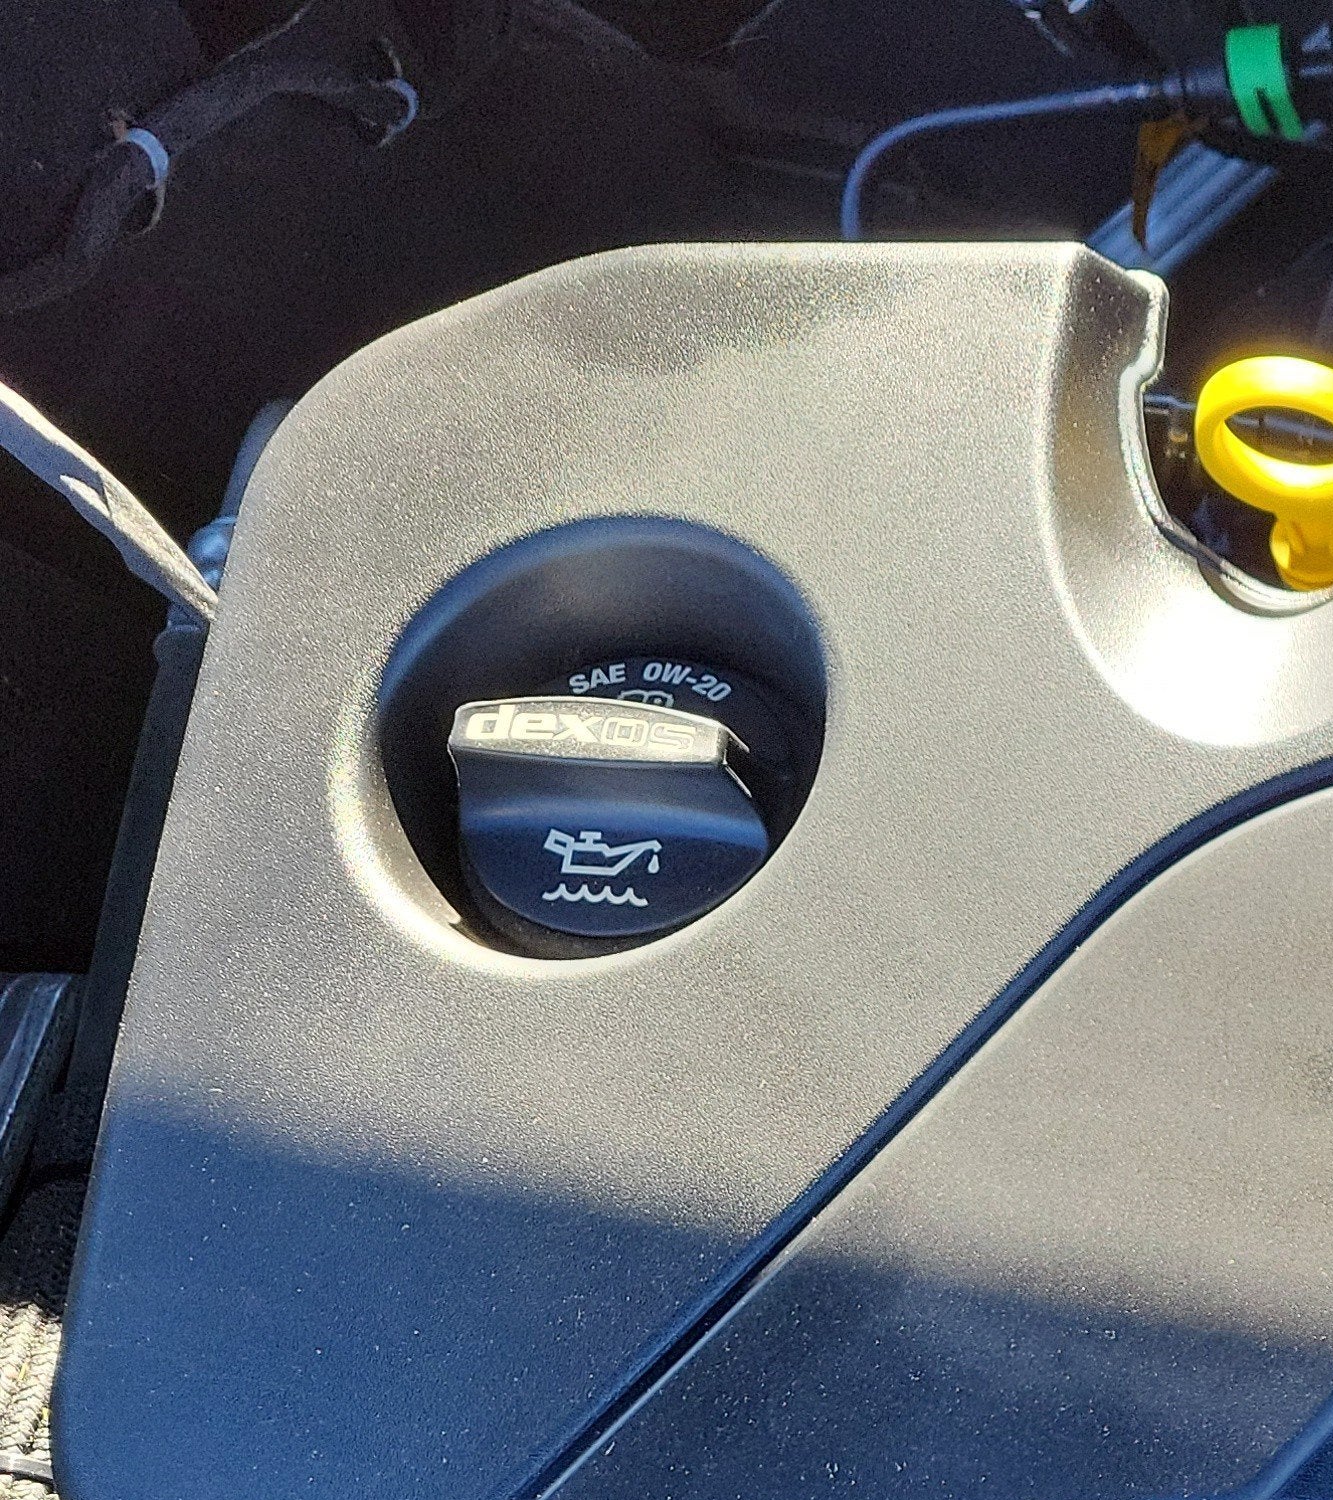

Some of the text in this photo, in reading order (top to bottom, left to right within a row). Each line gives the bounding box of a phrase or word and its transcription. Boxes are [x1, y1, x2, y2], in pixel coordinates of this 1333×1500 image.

[569, 662, 733, 702] SAE 0W-20
[466, 704, 696, 750] dexos
